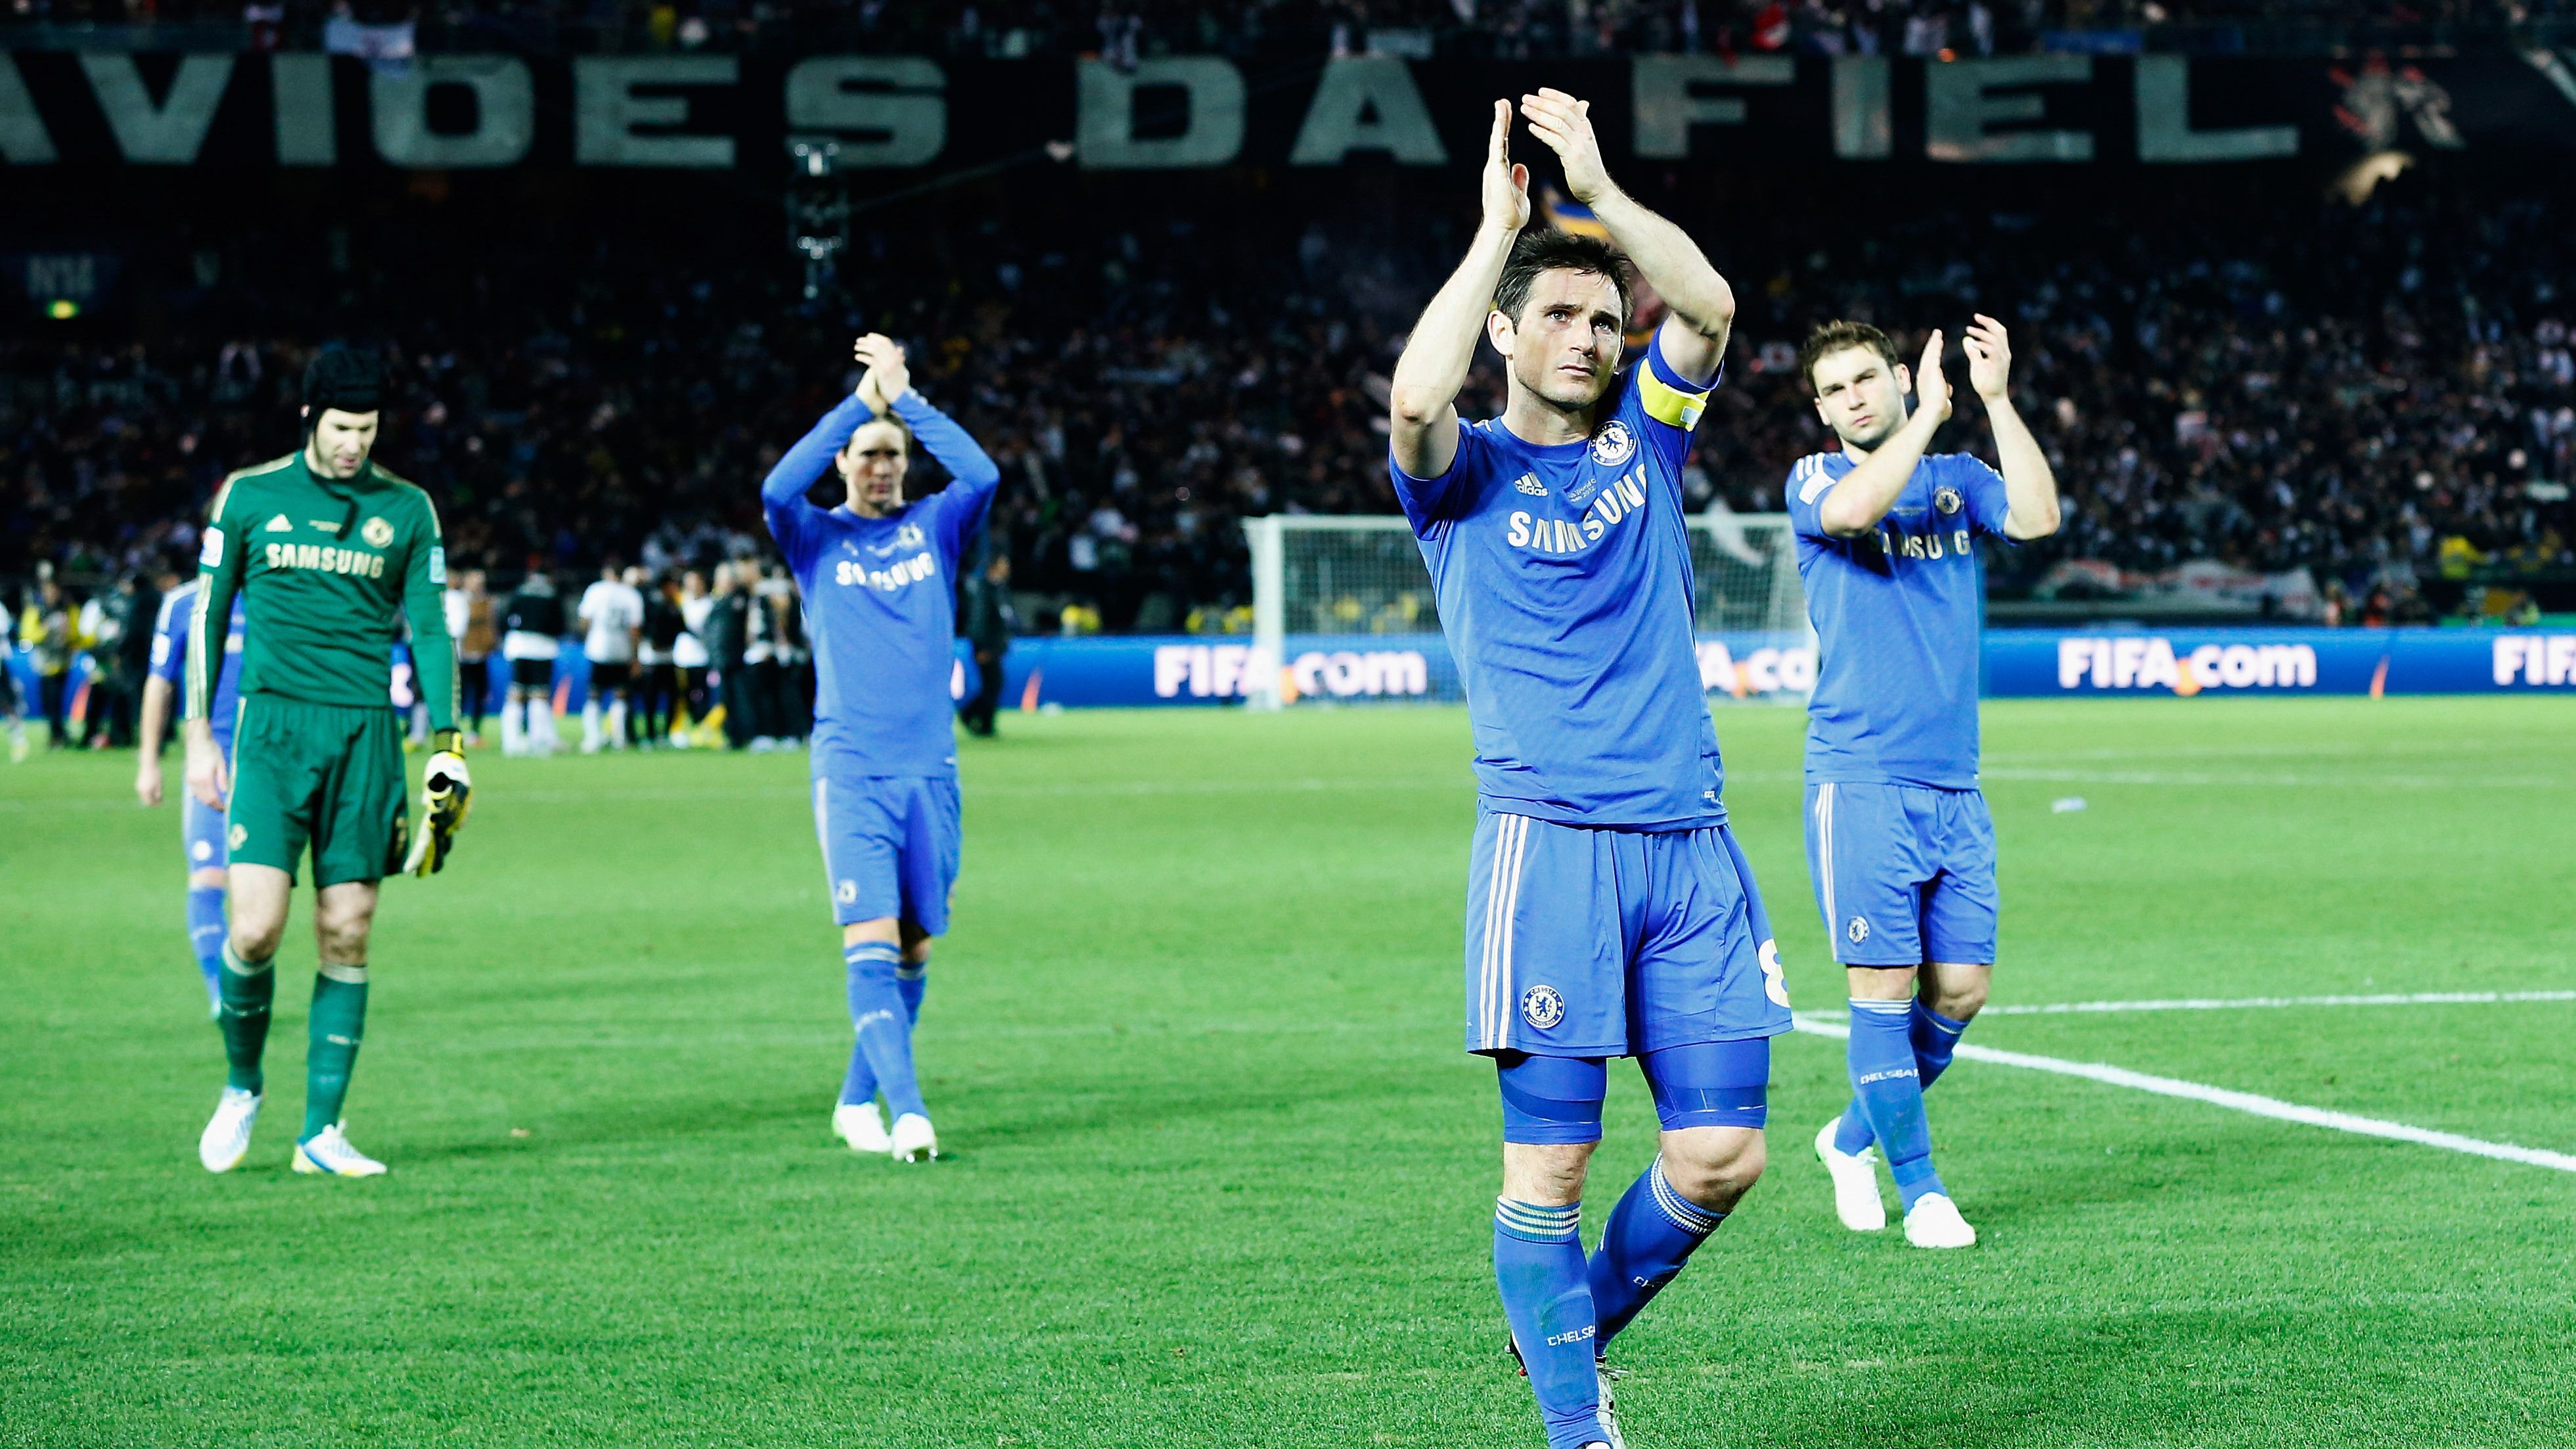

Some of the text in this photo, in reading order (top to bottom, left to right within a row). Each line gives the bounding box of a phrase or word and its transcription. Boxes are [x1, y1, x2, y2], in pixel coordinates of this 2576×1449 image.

[1075, 55, 1449, 168] DA
[1632, 53, 2299, 163] FIEL
[1514, 484, 1548, 497] adidas
[265, 543, 384, 578] SAMSUNG
[2058, 637, 2318, 695] FIFA.com
[2493, 635, 2576, 685] FIF
